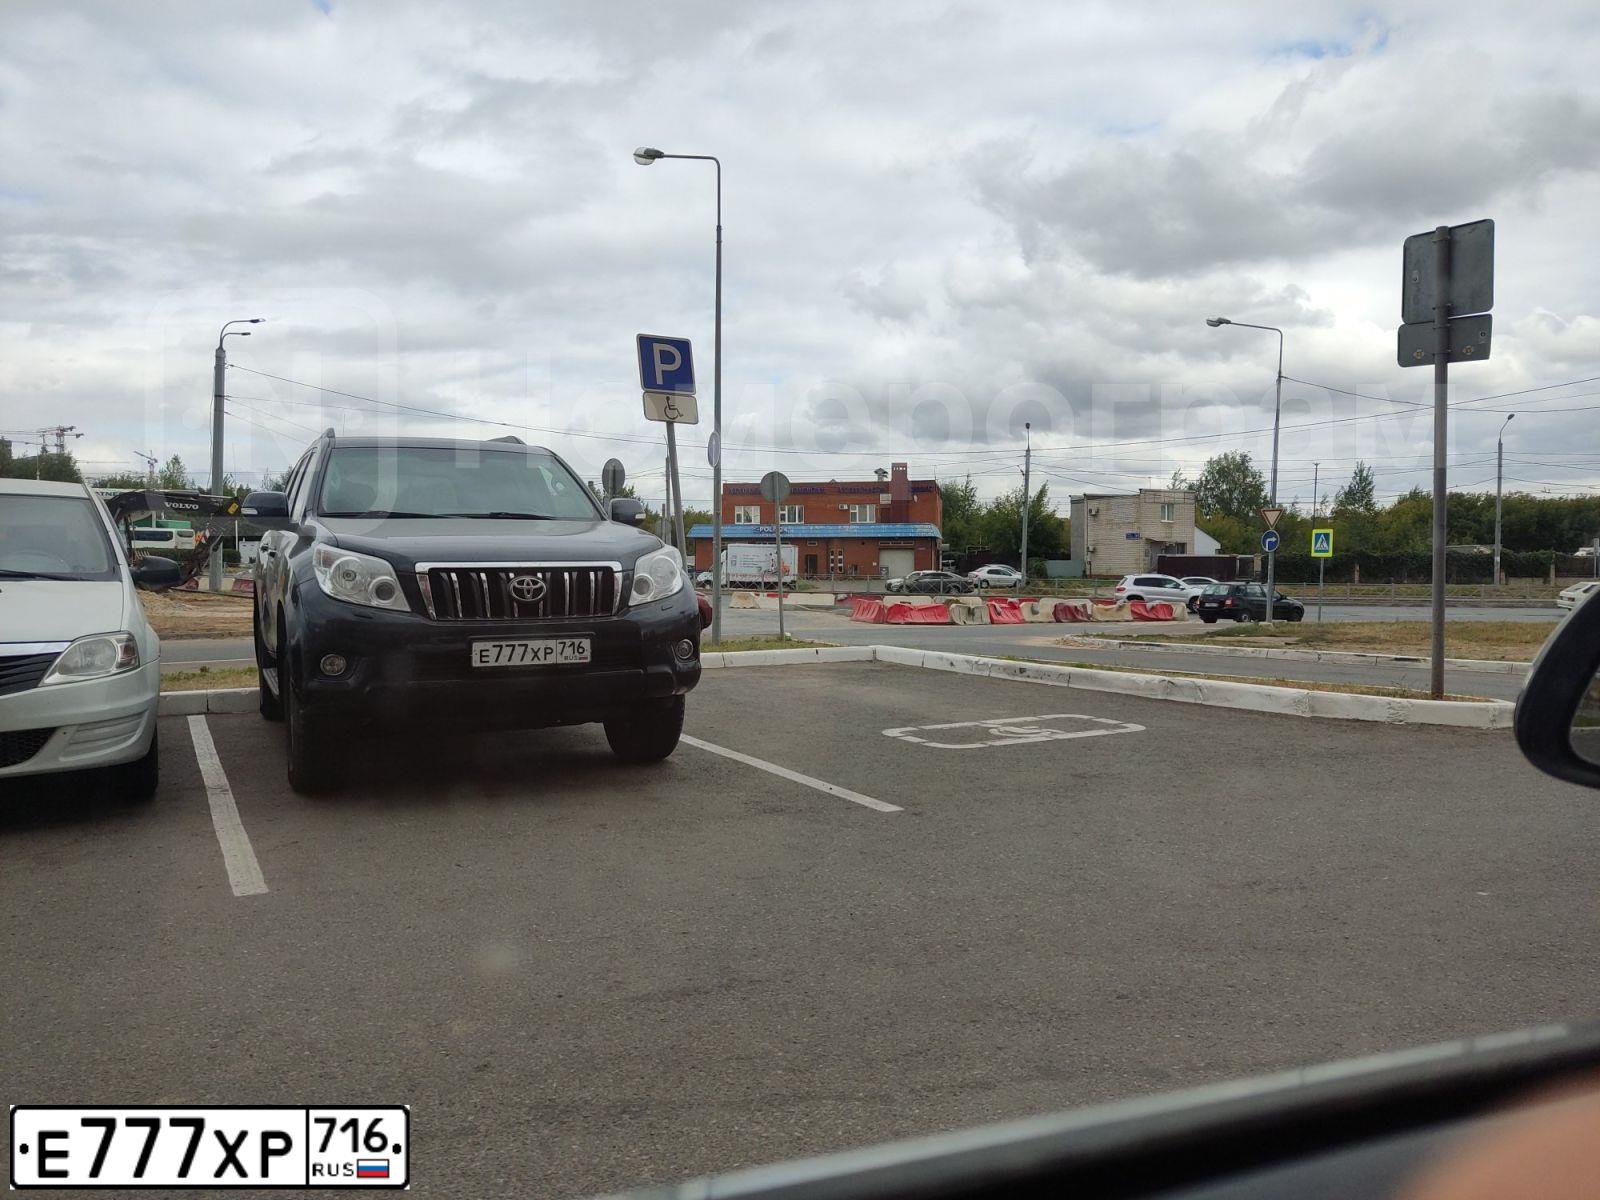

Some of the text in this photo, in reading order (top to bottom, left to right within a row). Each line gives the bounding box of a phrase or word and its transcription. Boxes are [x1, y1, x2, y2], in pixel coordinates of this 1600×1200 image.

[653, 343, 682, 385] P
[164, 501, 199, 510] VOLVO
[558, 641, 586, 656] 716
